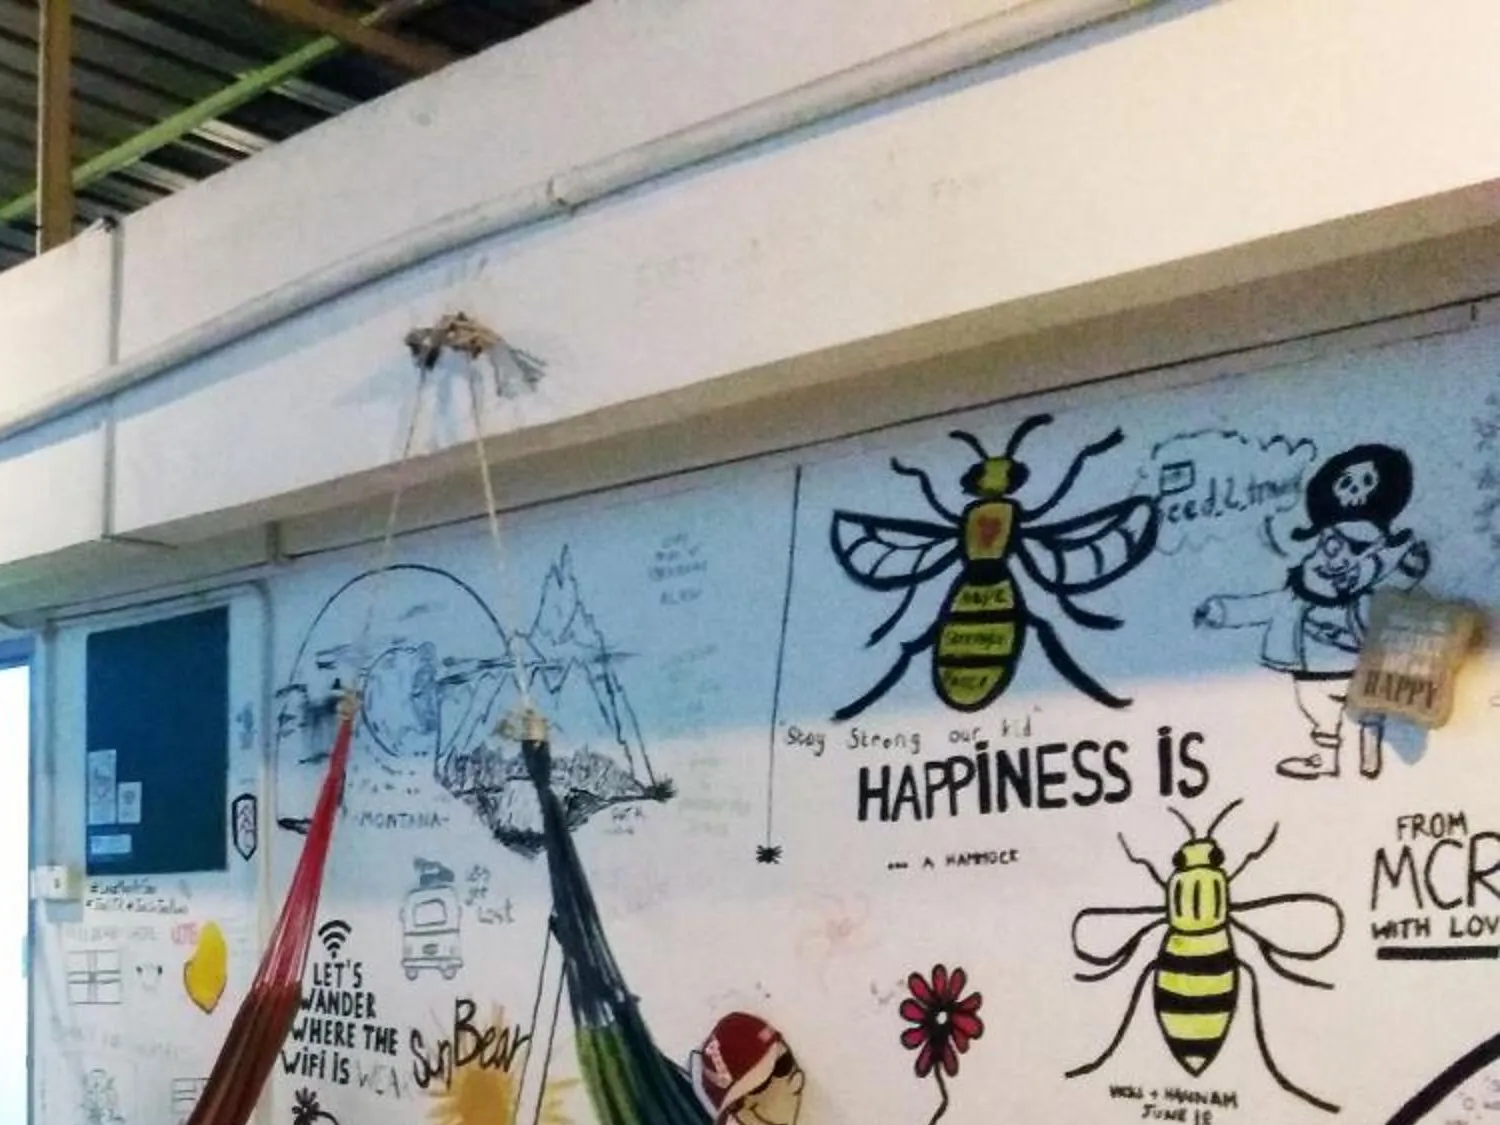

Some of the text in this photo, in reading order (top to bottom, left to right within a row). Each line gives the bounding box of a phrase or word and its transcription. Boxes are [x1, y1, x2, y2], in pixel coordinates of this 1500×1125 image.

[850, 727, 921, 754] Strong
[949, 726, 981, 744] our
[1397, 811, 1468, 841] FROM
[923, 856, 935, 868] A
[946, 849, 1019, 867] HAMMOCK
[1371, 831, 1500, 911] MCR
[1371, 916, 1431, 939] WITH
[314, 960, 363, 988] LET'S
[301, 989, 377, 1018] WANDER
[291, 1016, 399, 1056] WHERE THE
[1141, 1103, 1188, 1122] JUNE
